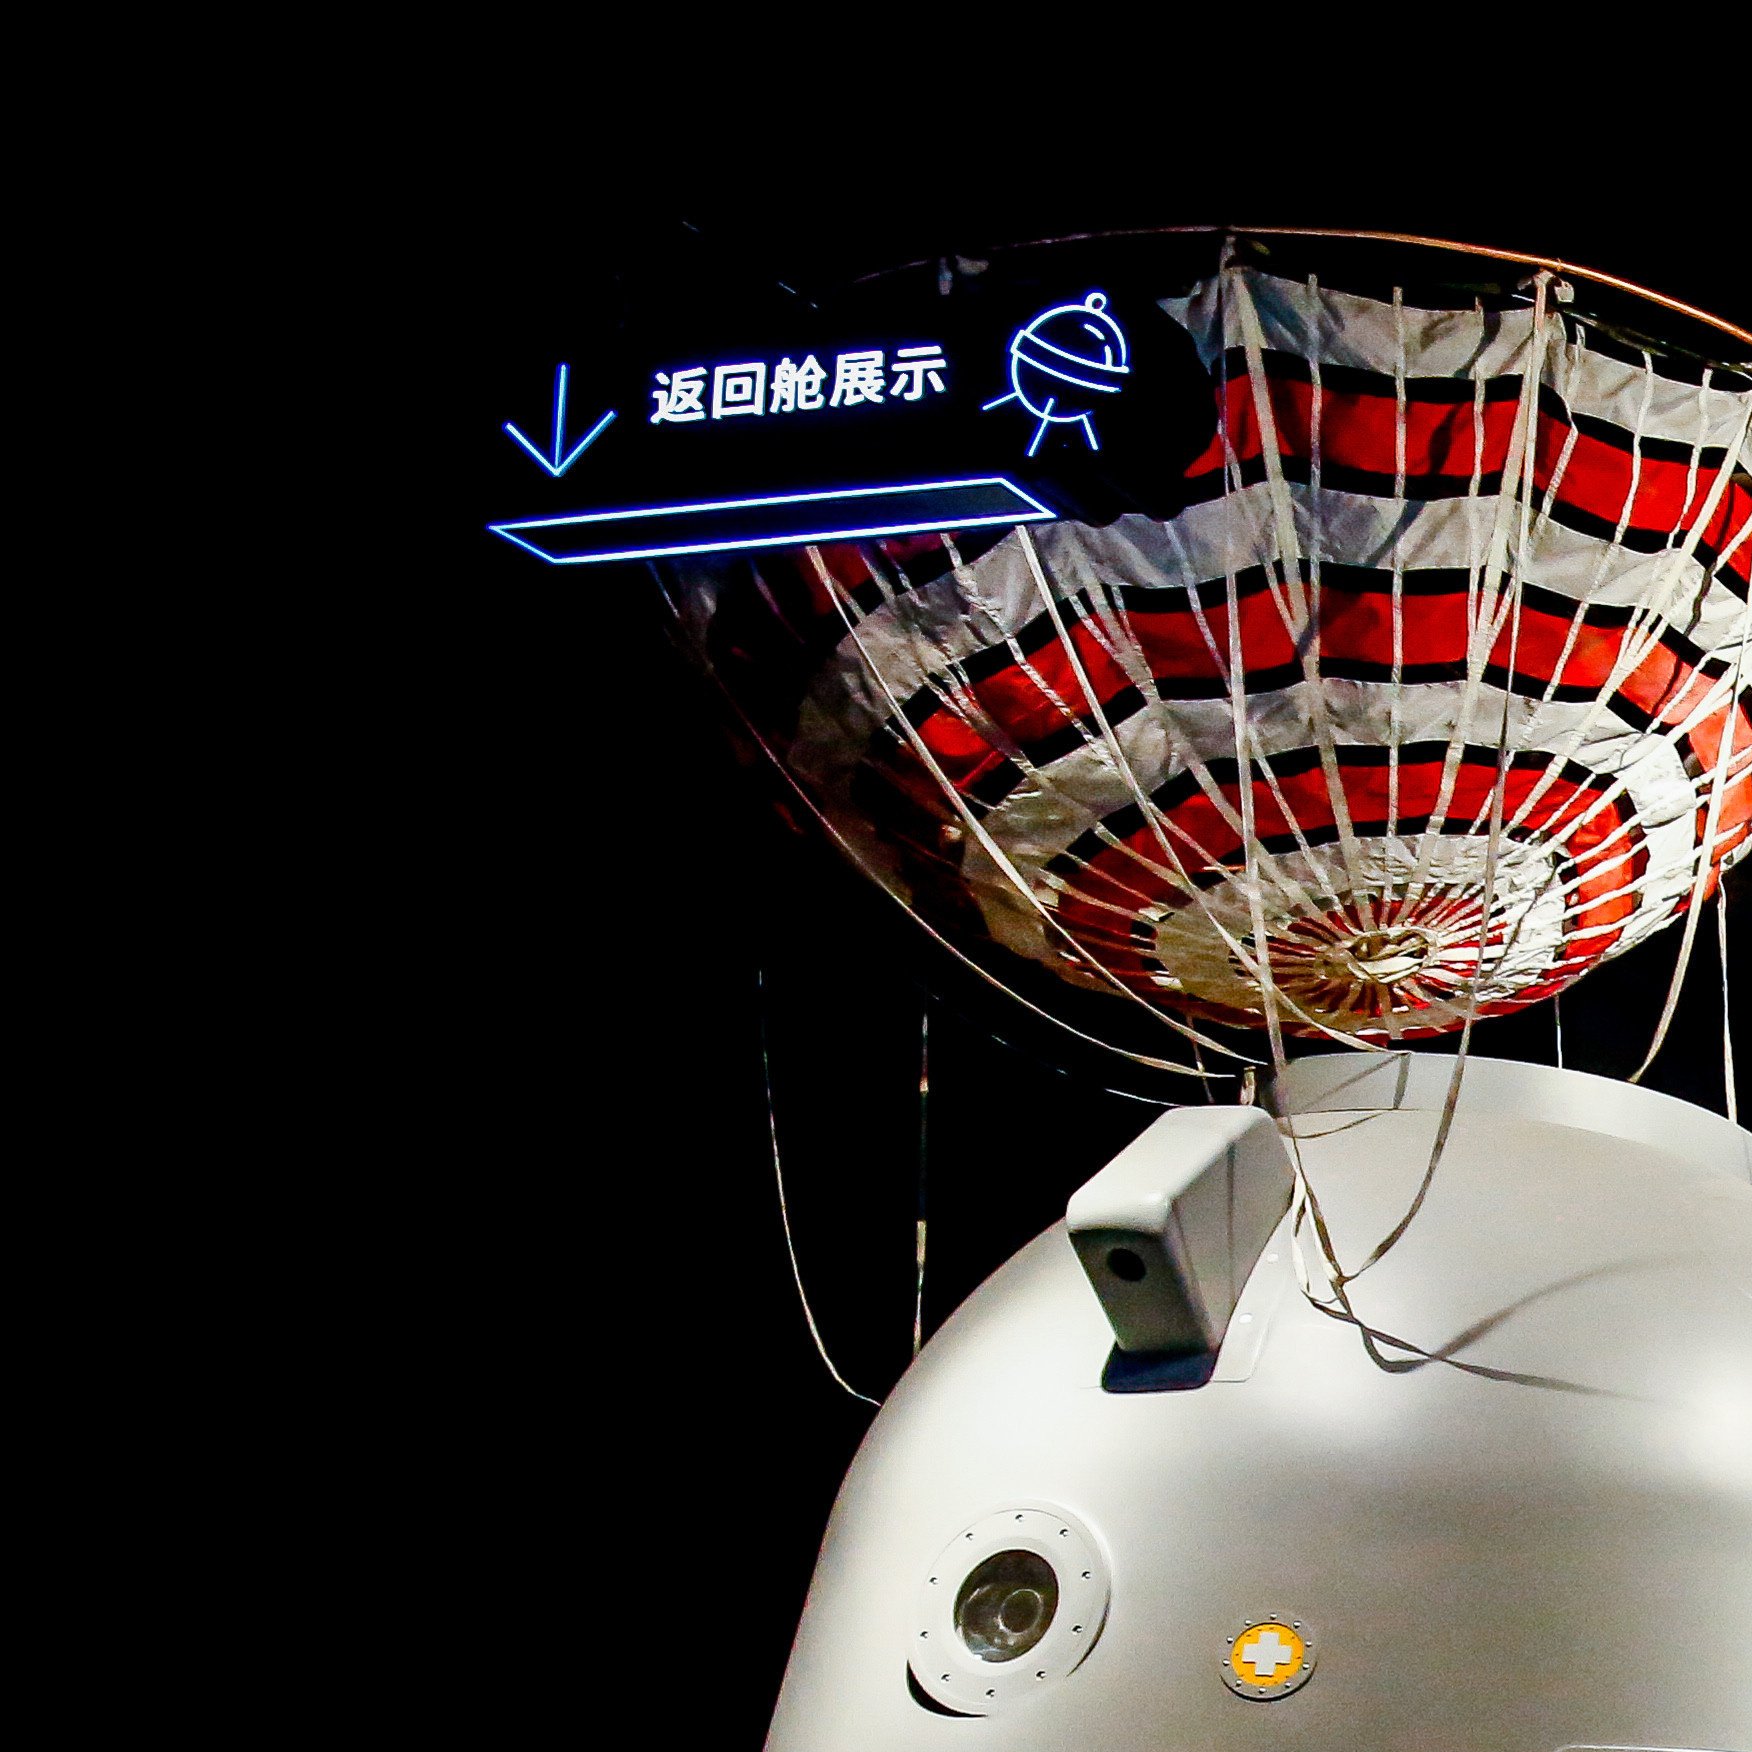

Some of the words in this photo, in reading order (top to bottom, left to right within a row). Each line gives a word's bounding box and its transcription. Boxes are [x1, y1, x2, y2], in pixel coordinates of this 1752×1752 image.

[650, 345, 948, 425] 返回舱展示
